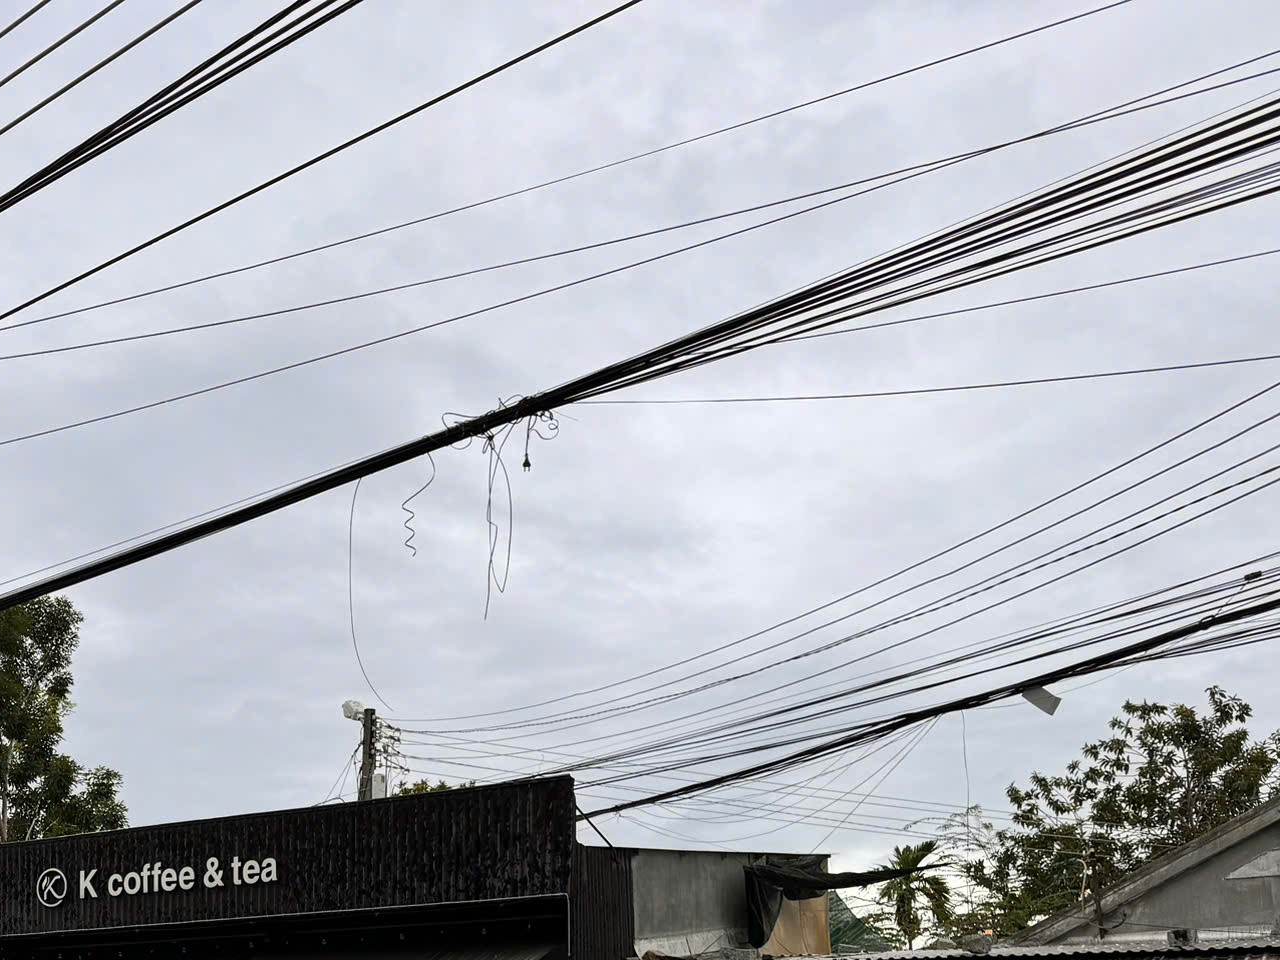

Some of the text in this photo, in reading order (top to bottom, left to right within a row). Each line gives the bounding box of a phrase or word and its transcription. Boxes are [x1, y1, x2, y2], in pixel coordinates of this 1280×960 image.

[79, 855, 278, 899] K coffee & tea
